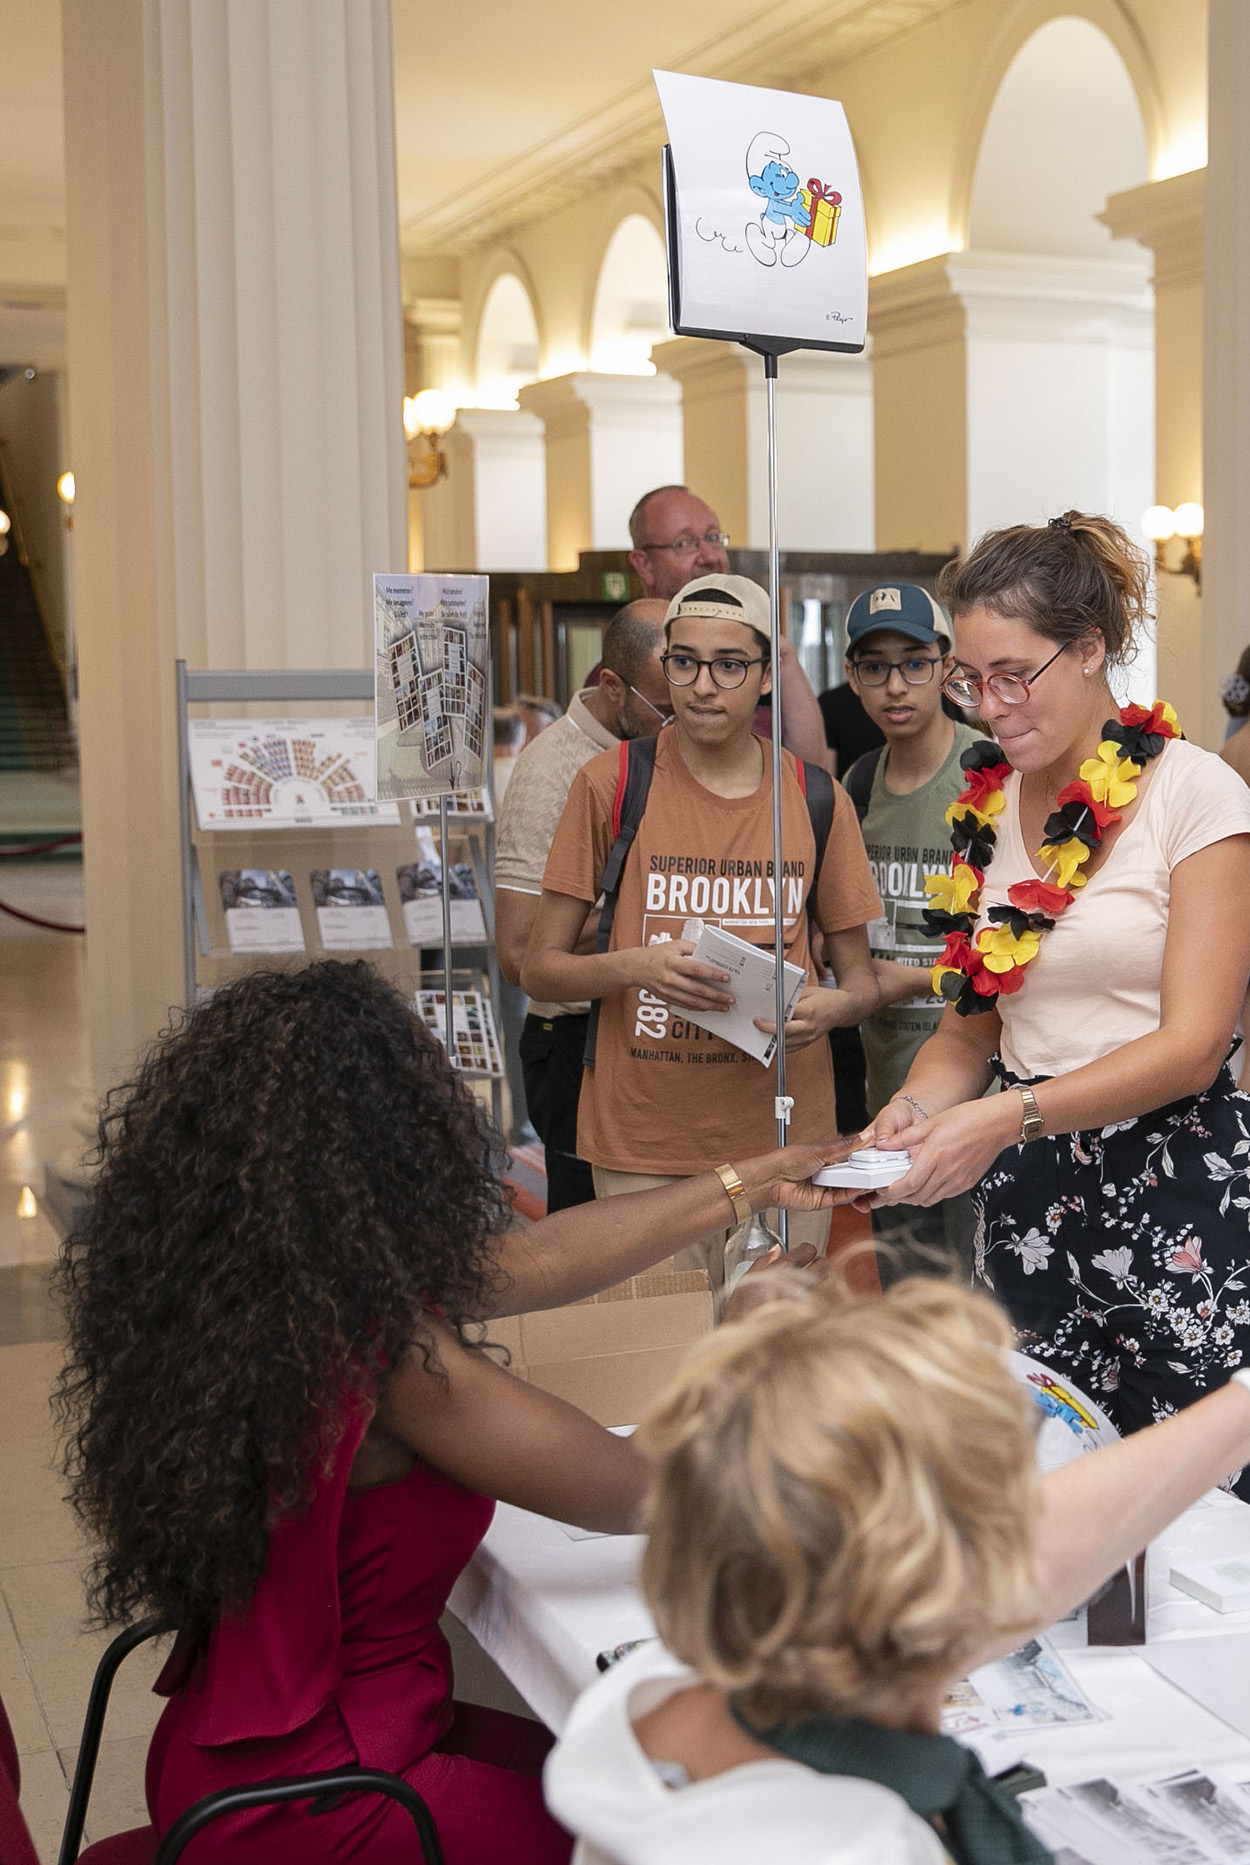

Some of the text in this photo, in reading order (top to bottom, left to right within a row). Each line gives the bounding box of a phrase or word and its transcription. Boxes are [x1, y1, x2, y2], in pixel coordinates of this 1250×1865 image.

[650, 855, 805, 877] SUPERIOR URBAN BAND
[646, 873, 804, 914] BROOKLYN
[630, 1047, 684, 1064] MANHATTAN,
[687, 1053, 703, 1064] THE
